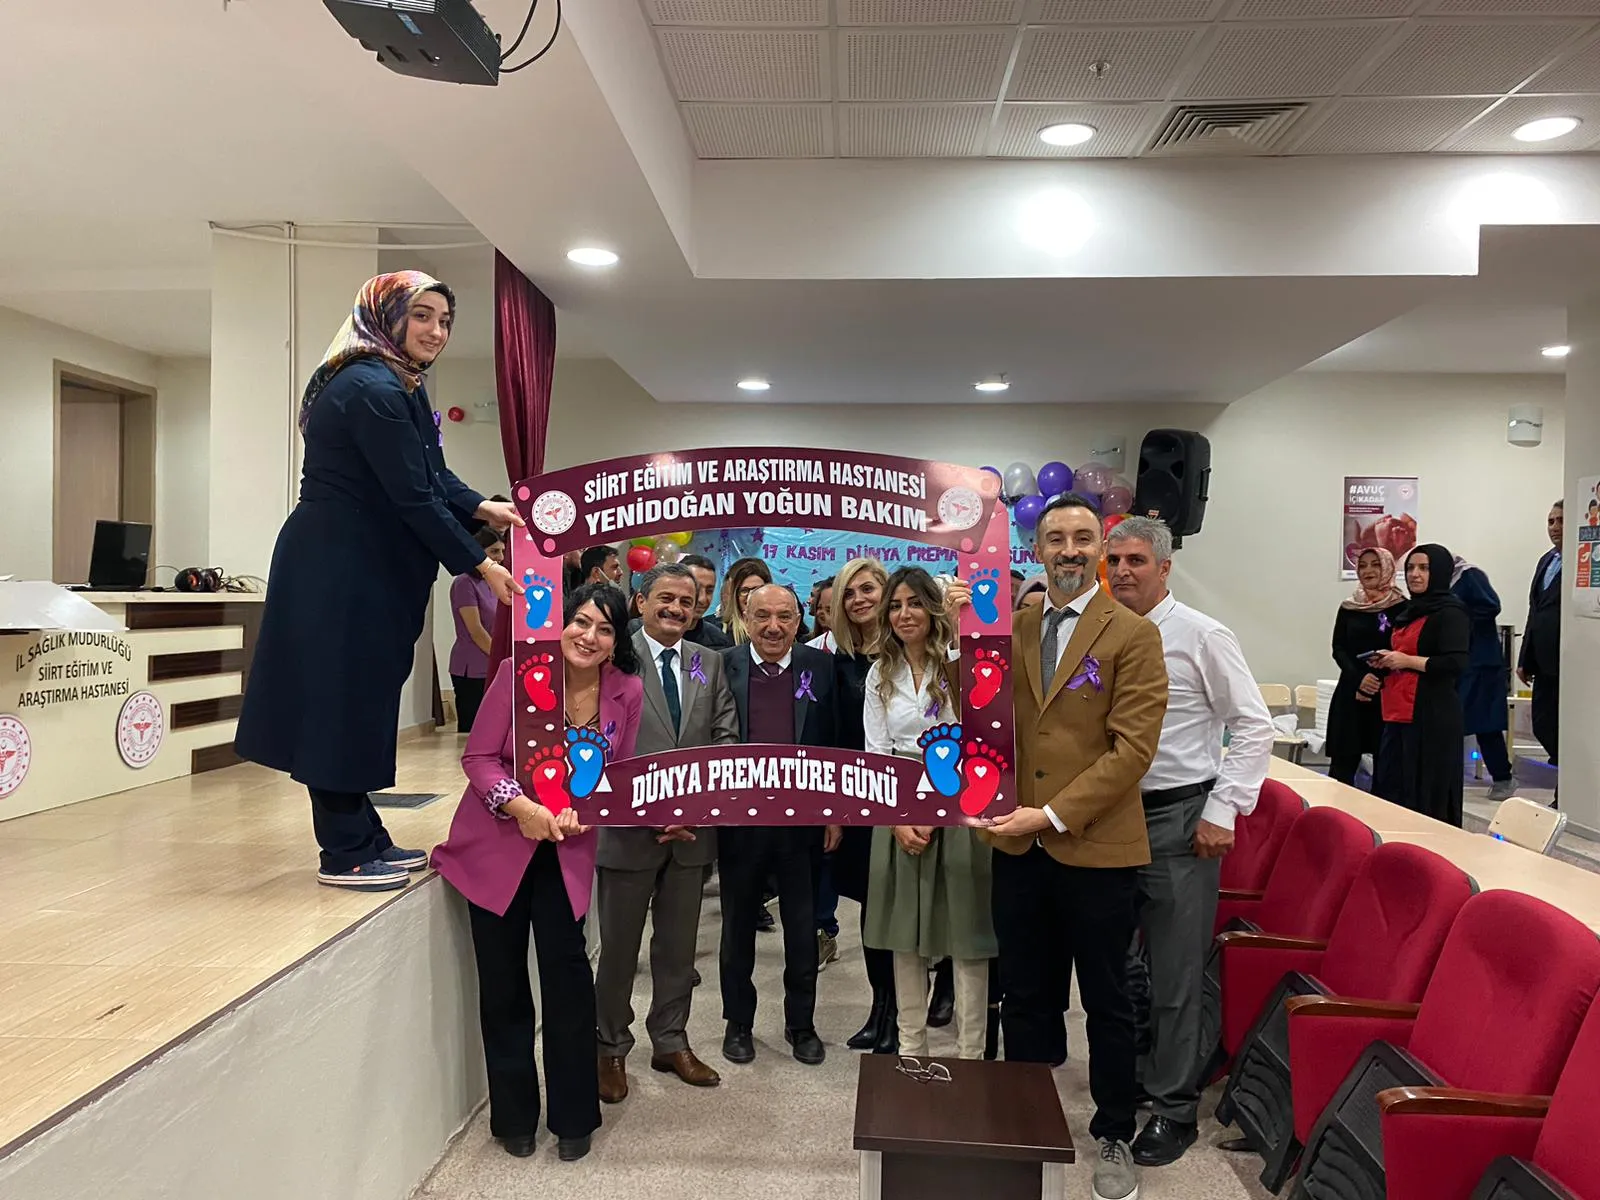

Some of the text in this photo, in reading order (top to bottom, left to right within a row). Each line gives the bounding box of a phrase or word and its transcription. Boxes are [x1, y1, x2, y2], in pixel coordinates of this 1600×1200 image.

[584, 458, 926, 504] SİİRT EĞİTİM VE ARAŞTIRMA HASTANESİ
[584, 489, 735, 536] YENİDOĞAN
[742, 487, 832, 517] YOĞUN
[841, 495, 927, 533] BAKIM
[762, 544, 778, 559] 17
[786, 544, 836, 561] KASIM
[907, 545, 958, 561] PREMA
[38, 660, 113, 681] SİİRT EĞİTİM VE
[18, 678, 130, 708] ARAŞTIRMA HASTANESİ
[631, 750, 898, 809] DÜNYA PREMATÜRE GÜNÜ
